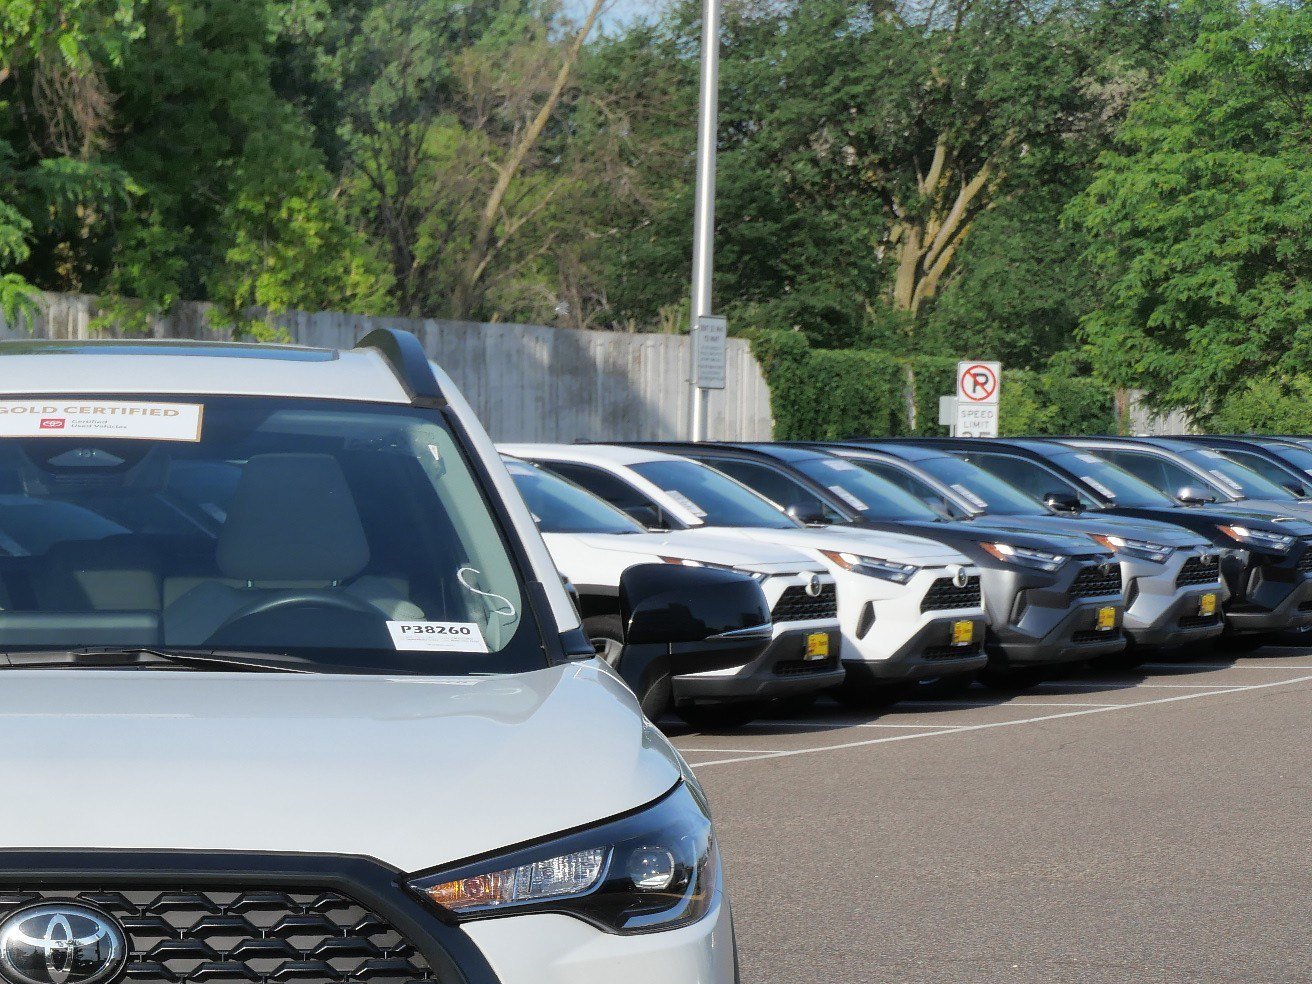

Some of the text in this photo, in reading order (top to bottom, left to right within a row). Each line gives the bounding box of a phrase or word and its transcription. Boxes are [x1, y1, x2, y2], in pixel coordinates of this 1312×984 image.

[63, 406, 180, 417] CERTIFIED
[960, 410, 994, 419] SPEED
[963, 421, 990, 429] LIMIT
[400, 625, 471, 635] P38260
